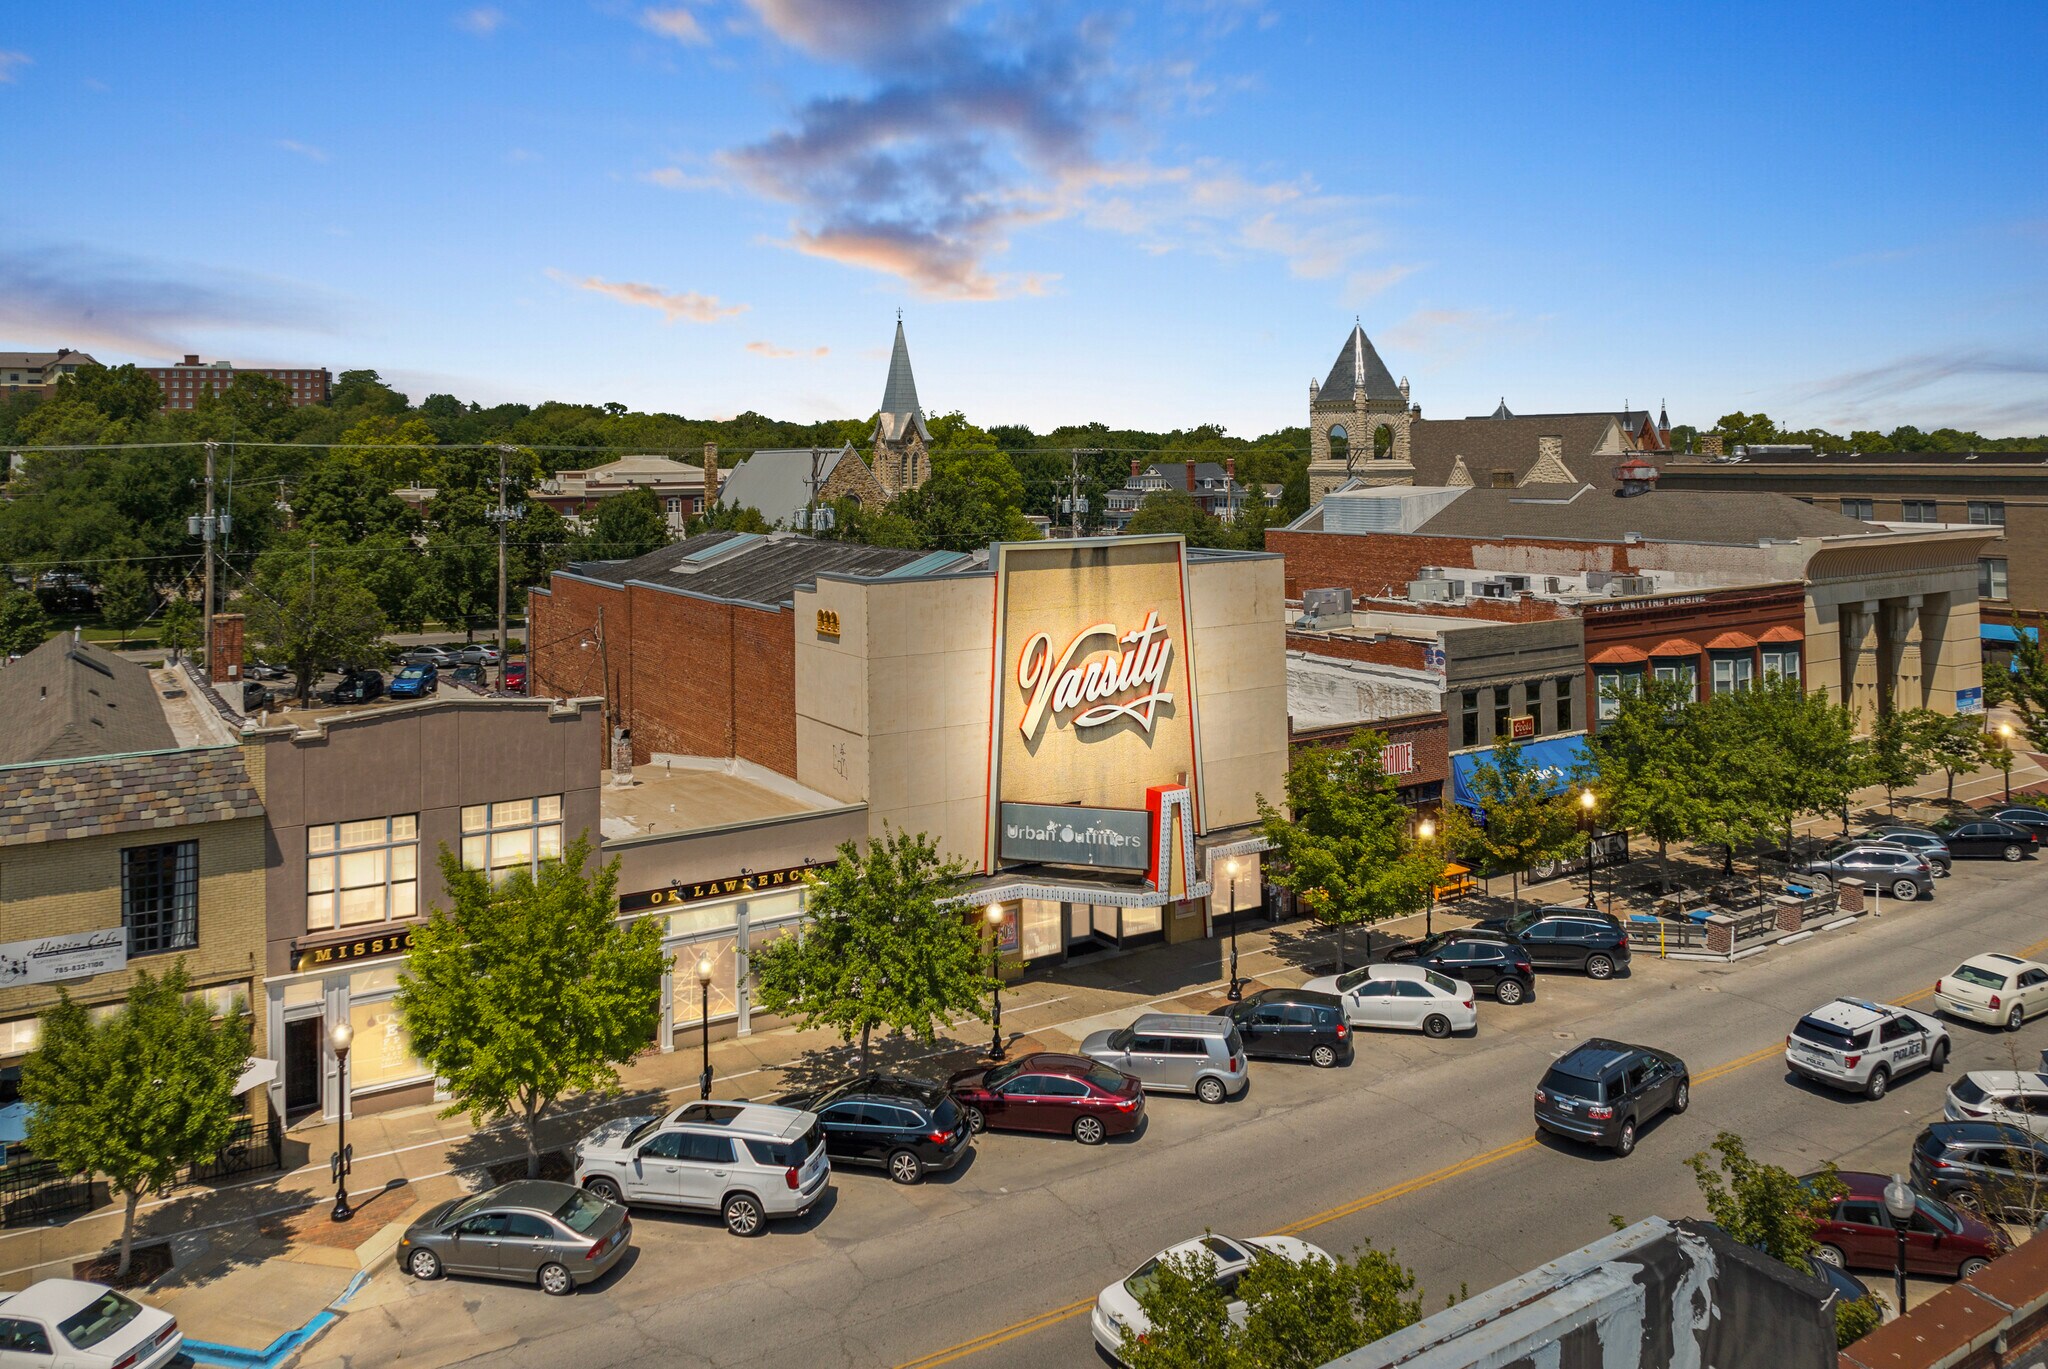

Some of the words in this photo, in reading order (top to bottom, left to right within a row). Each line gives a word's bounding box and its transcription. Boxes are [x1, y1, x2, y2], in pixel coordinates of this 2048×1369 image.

[1595, 605, 1614, 613] TRY
[1620, 599, 1665, 610] WRITING
[1668, 595, 1706, 606] CURSIVE
[1018, 611, 1174, 741] Varsity
[1378, 743, 1411, 776] RANDE
[1007, 824, 1056, 841] Urban
[1060, 826, 1142, 847] Outfitters
[651, 890, 679, 904] OF
[315, 935, 417, 962] MISSIO
[1806, 1056, 1825, 1067] POLICE
[1893, 1042, 1921, 1062] POLICE
